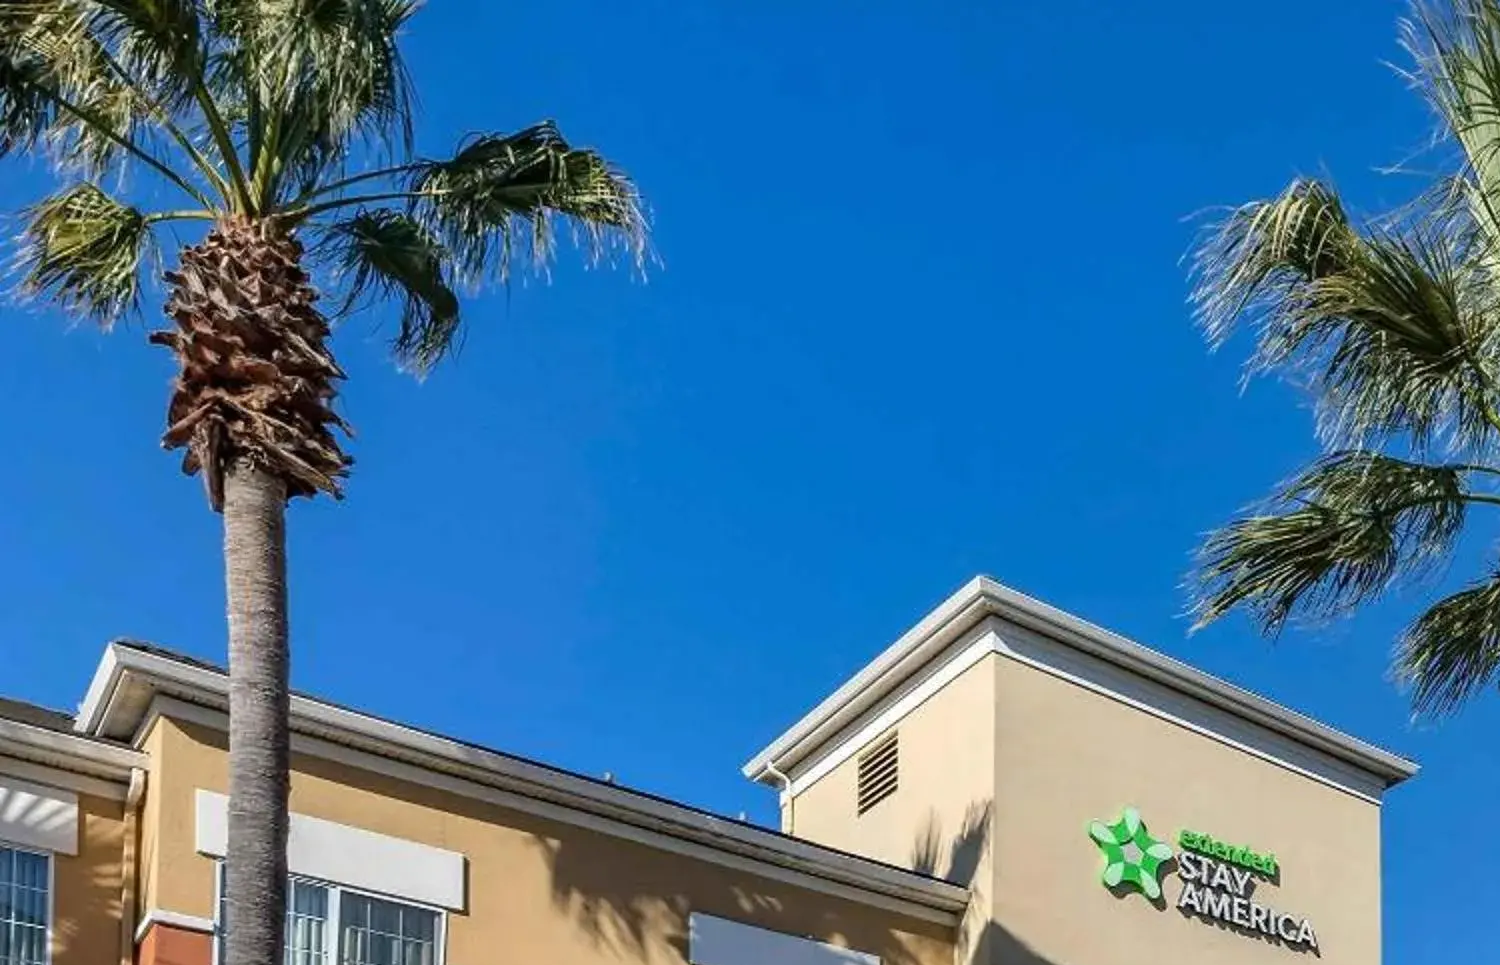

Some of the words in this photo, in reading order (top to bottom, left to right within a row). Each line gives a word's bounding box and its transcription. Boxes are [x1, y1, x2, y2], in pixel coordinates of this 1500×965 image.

[1178, 829, 1275, 877] extended
[1178, 851, 1251, 896] STAY
[1178, 882, 1318, 948] AMERICA
